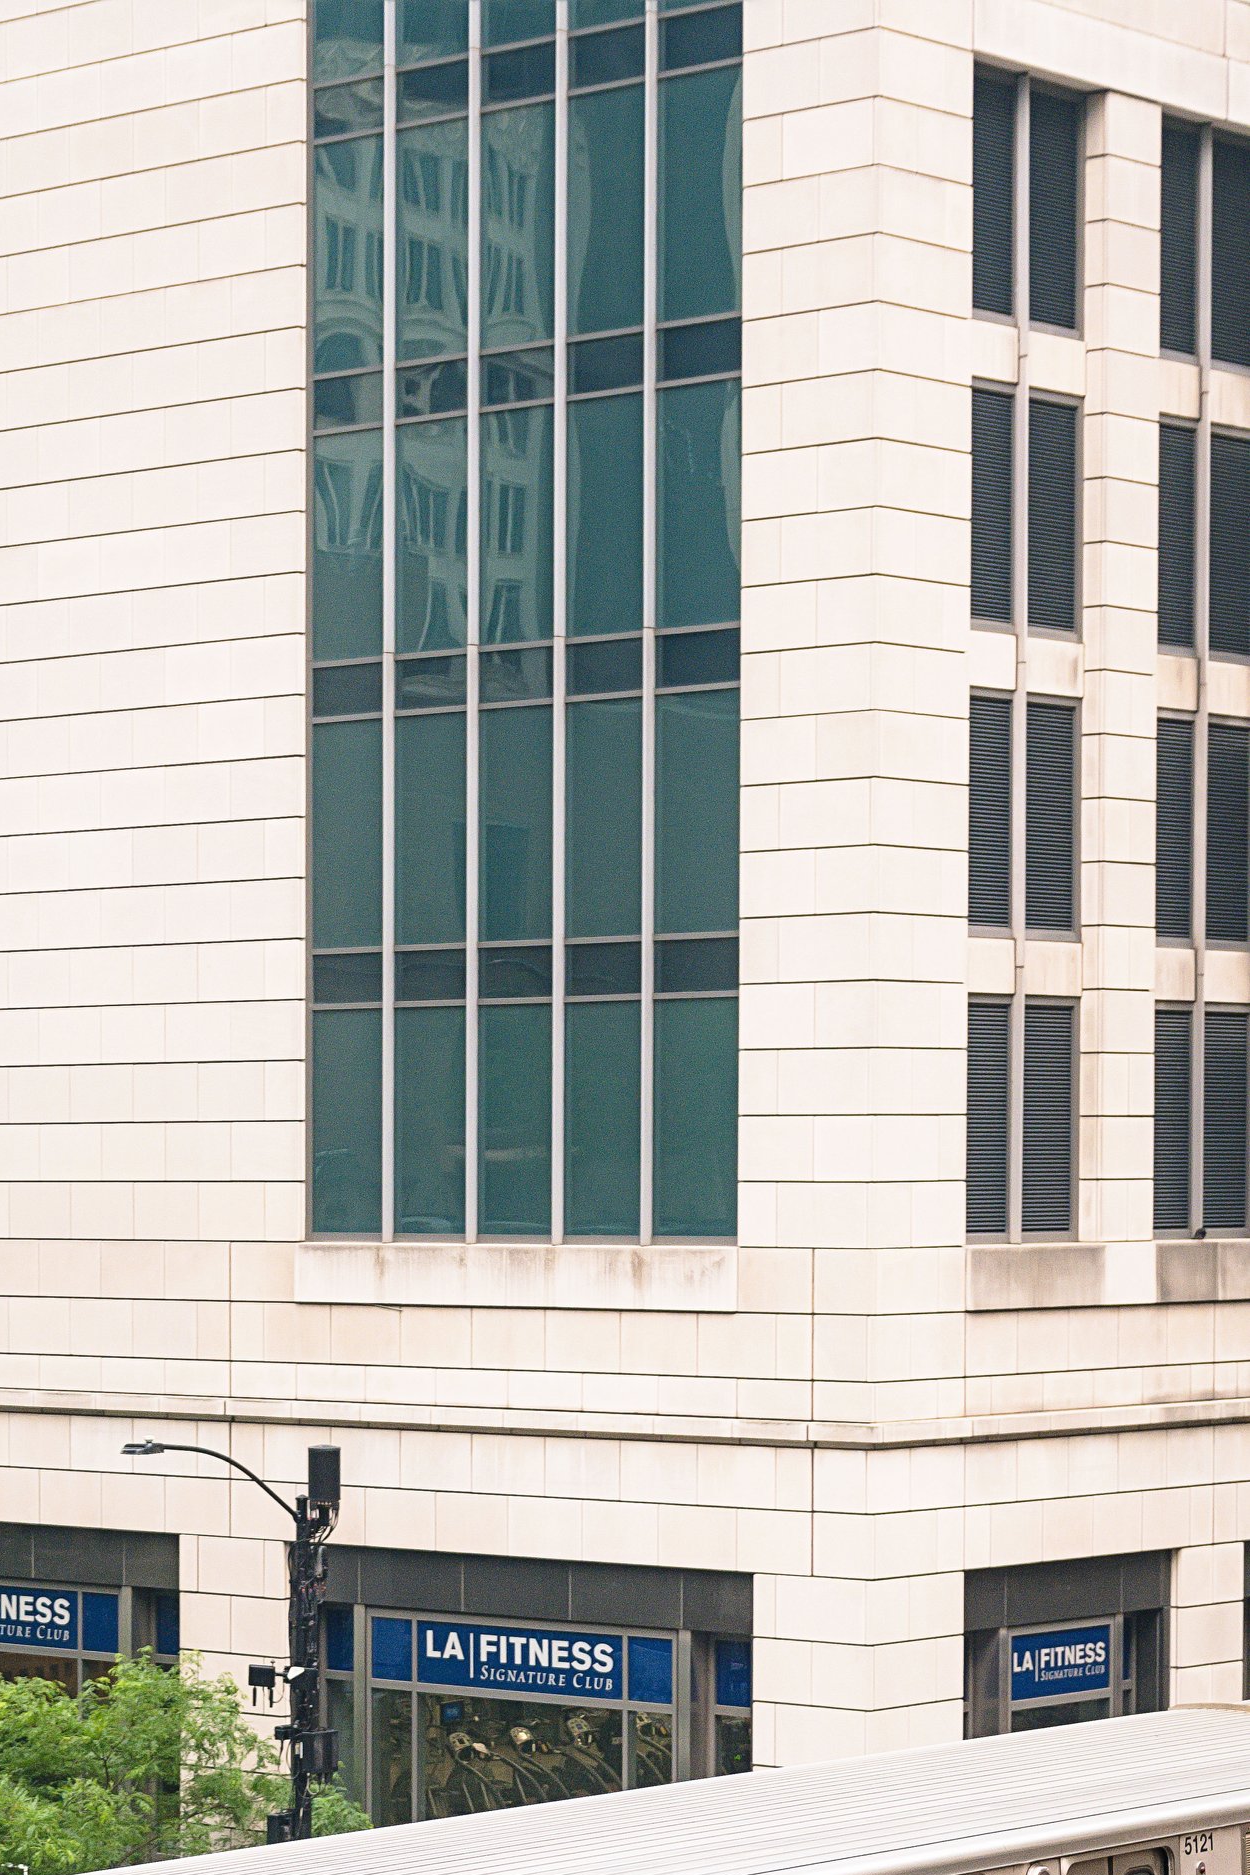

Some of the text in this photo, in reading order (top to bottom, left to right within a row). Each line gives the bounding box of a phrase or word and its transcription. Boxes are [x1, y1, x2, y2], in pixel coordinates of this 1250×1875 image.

[36, 1625, 70, 1641] CLUB
[426, 1629, 614, 1673] LA FITNESS
[1013, 1641, 1106, 1673] LA FITNESS
[480, 1665, 614, 1691] SIGNATURE CLUB
[1040, 1664, 1105, 1681] SIGNATURE CLUB
[1185, 1832, 1213, 1855] 5121
